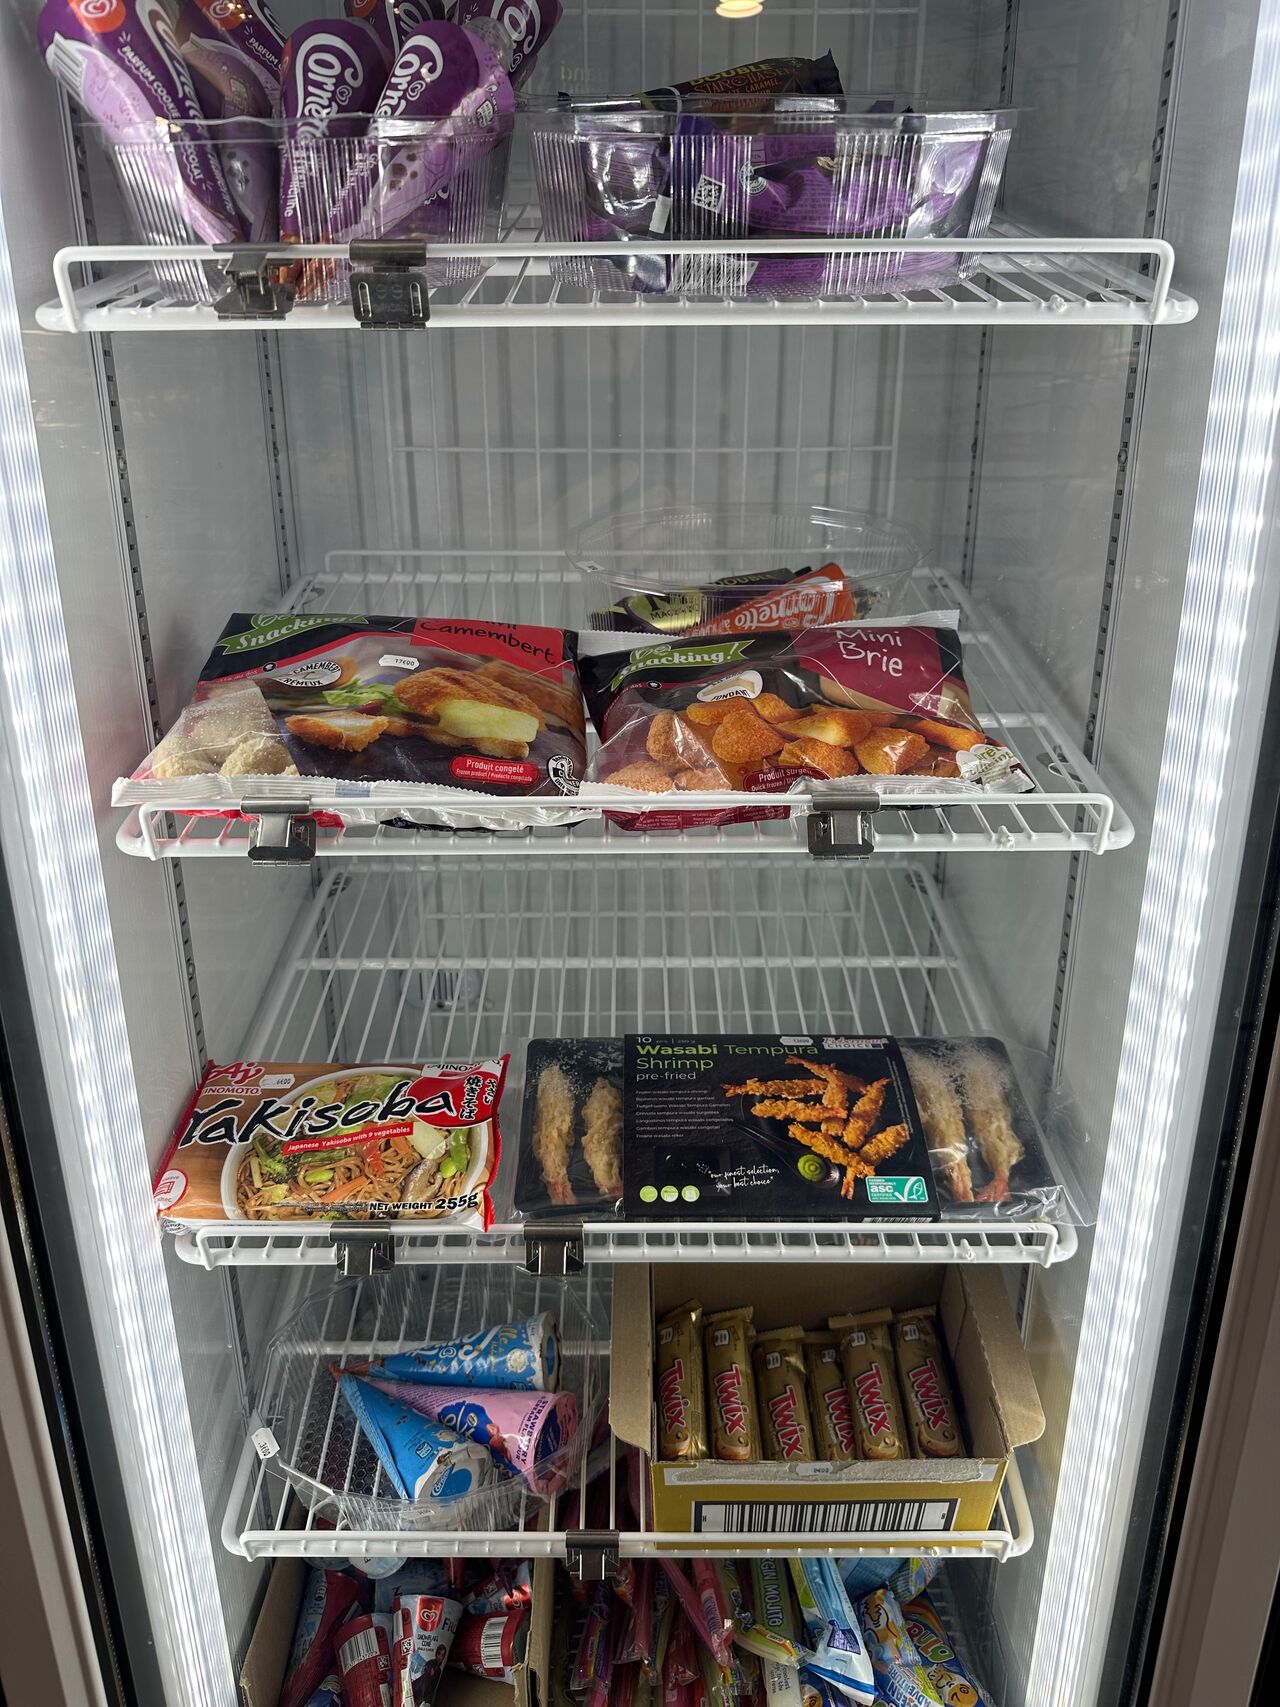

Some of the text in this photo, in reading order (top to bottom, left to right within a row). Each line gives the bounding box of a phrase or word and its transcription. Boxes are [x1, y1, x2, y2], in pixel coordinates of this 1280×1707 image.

[248, 37, 279, 65] PARFUM
[122, 46, 154, 81] PARFUM
[153, 81, 182, 119] COOKIE
[688, 63, 773, 87] DOUBLE
[735, 578, 835, 629] Cornetto
[420, 621, 557, 665] Camembert
[836, 630, 902, 647] Mini
[838, 641, 903, 677] Brie
[466, 759, 525, 775] Produit congelé
[758, 767, 785, 783] Produit
[751, 782, 766, 792] Quick
[766, 779, 783, 789] frozen
[636, 1044, 818, 1056] Wasabi Tempura
[636, 1057, 714, 1071] Shrimp
[636, 1072, 697, 1082] pre-fried
[287, 1141, 320, 1151] Japanese
[321, 1136, 352, 1148] Yakisoba
[352, 1132, 368, 1142] with
[373, 1126, 411, 1140] vegetables
[733, 1175, 749, 1188] best
[369, 1203, 389, 1211] NET
[392, 1202, 433, 1210] WEIGHT
[434, 1192, 479, 1210] 255g
[764, 1586, 784, 1628] MOJITO
